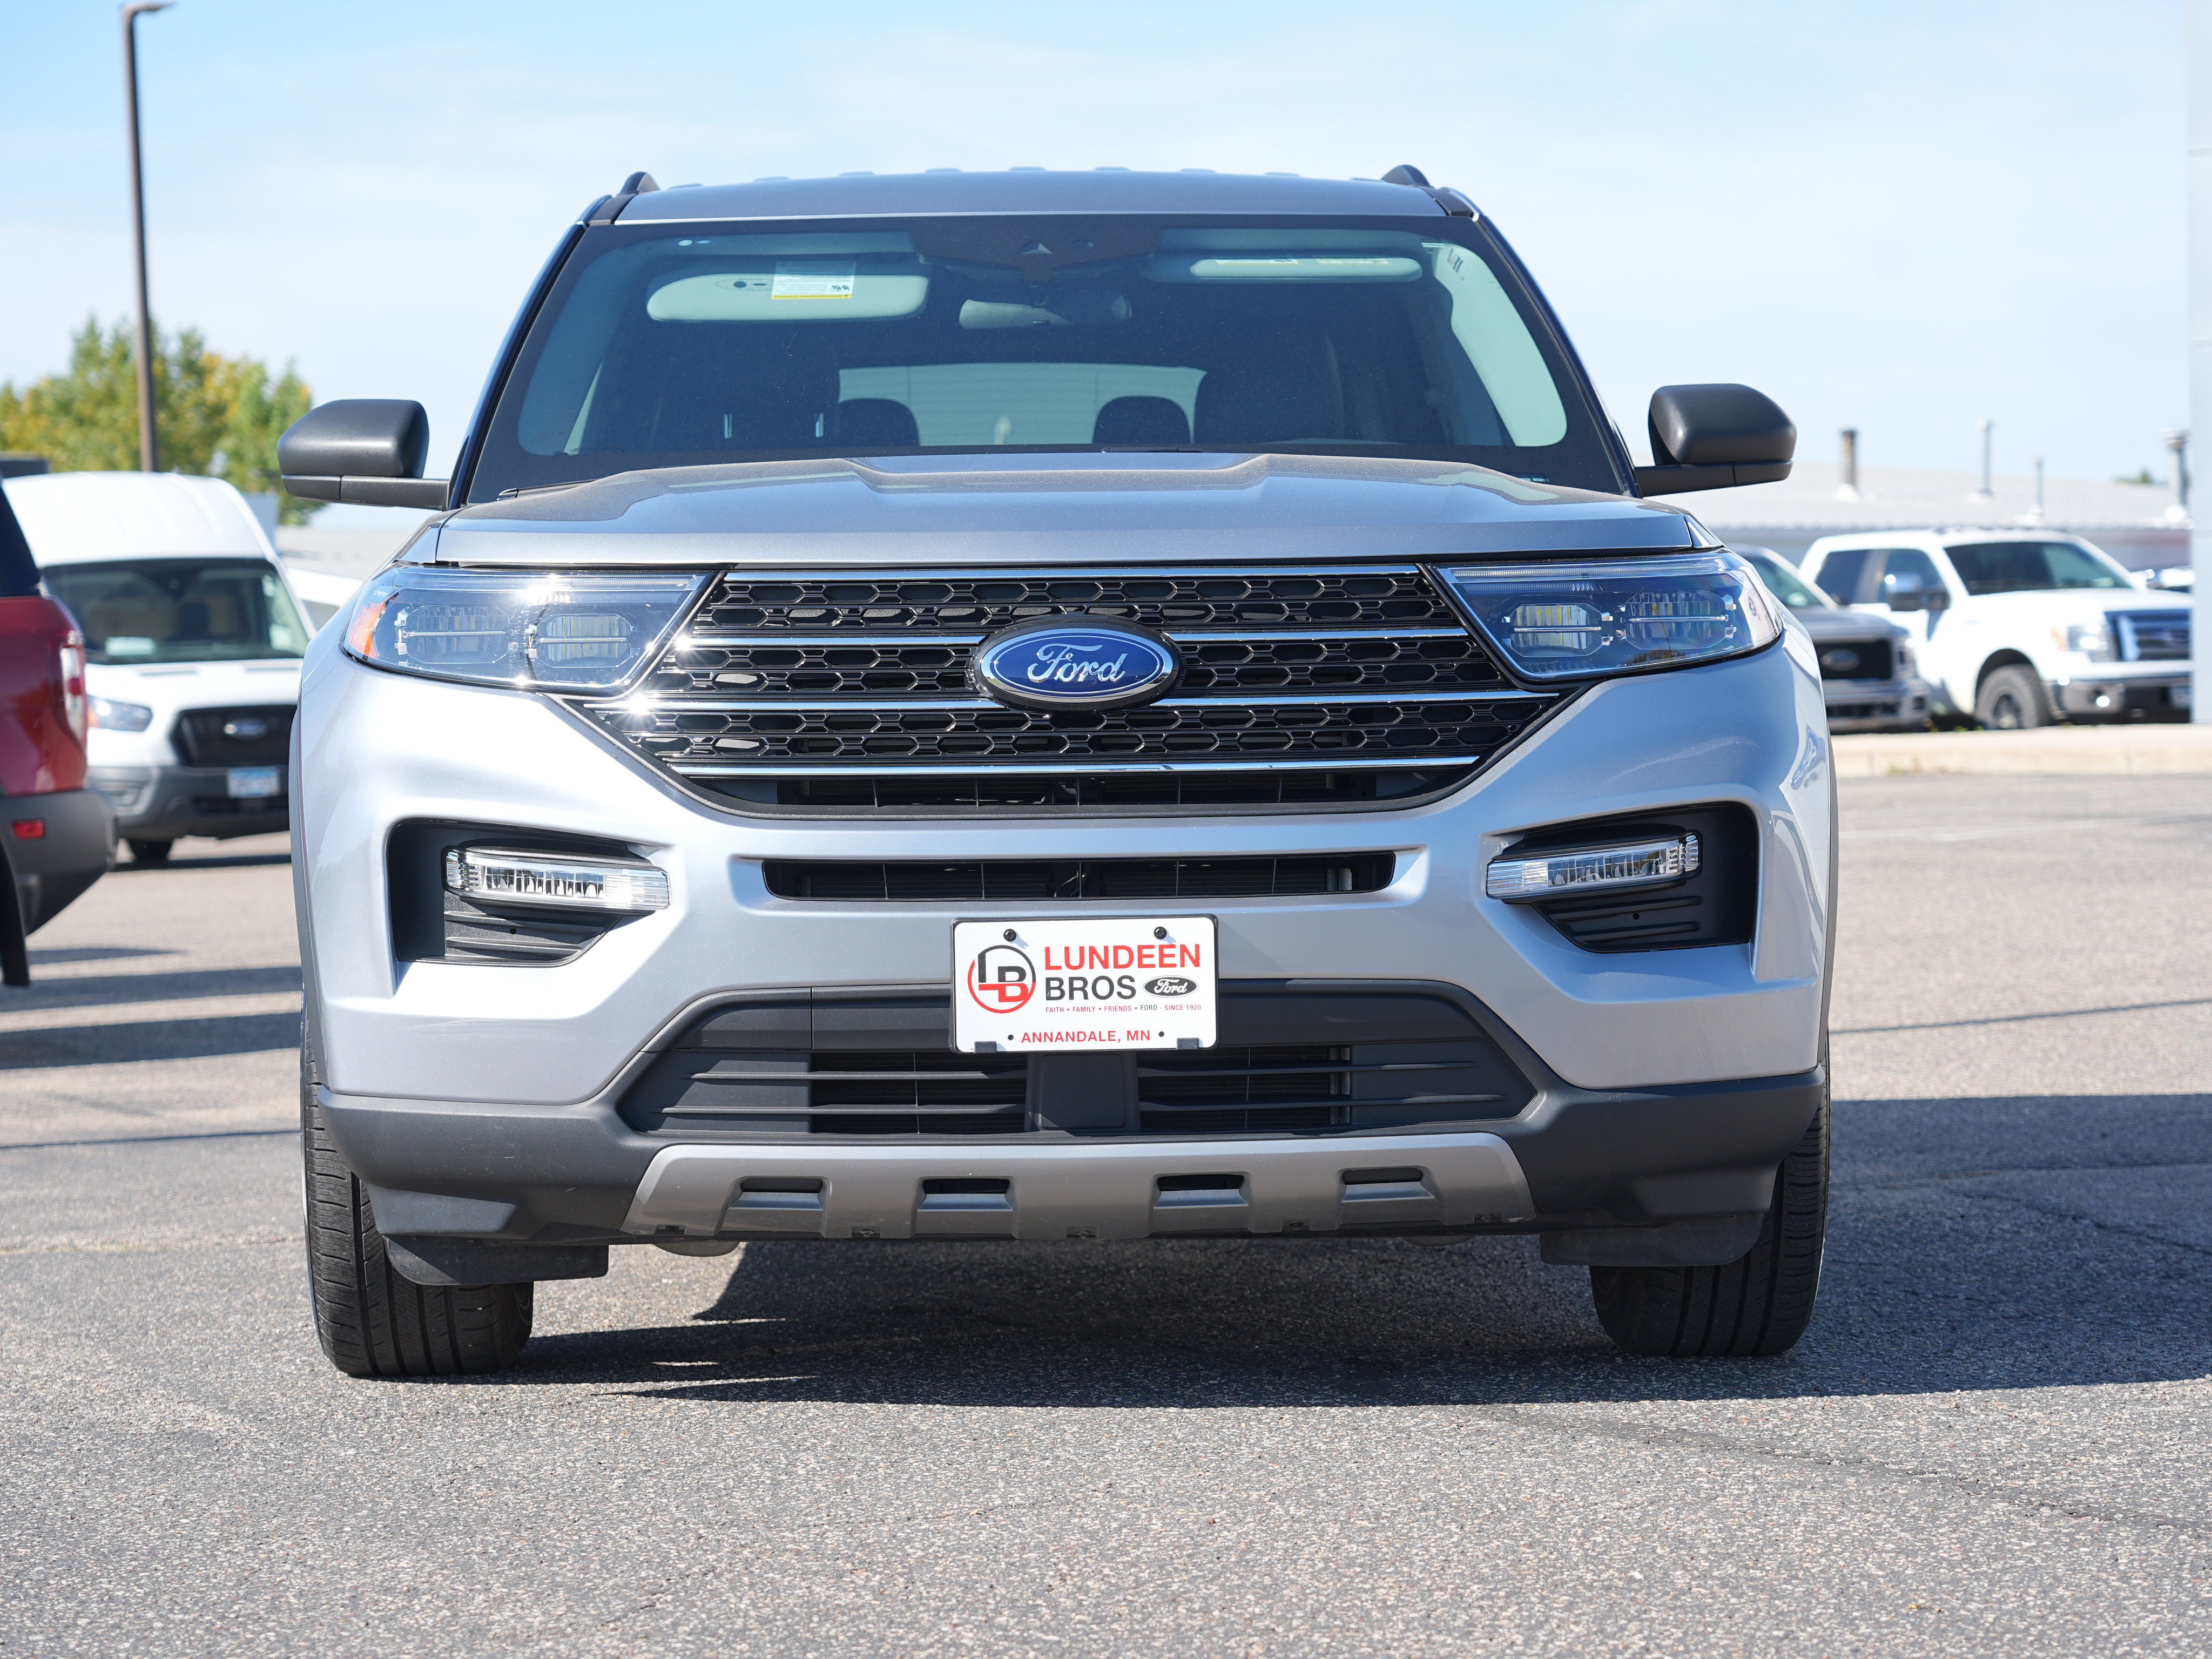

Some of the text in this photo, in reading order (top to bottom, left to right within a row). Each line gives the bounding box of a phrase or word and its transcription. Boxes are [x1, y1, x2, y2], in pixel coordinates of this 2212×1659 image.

[1027, 643, 1128, 683] Ford
[1045, 944, 1200, 970] LUNDEEN
[1046, 975, 1136, 1001] BROS
[1154, 978, 1188, 994] Ford
[1021, 1030, 1150, 1043] ANNANDALE, MN
